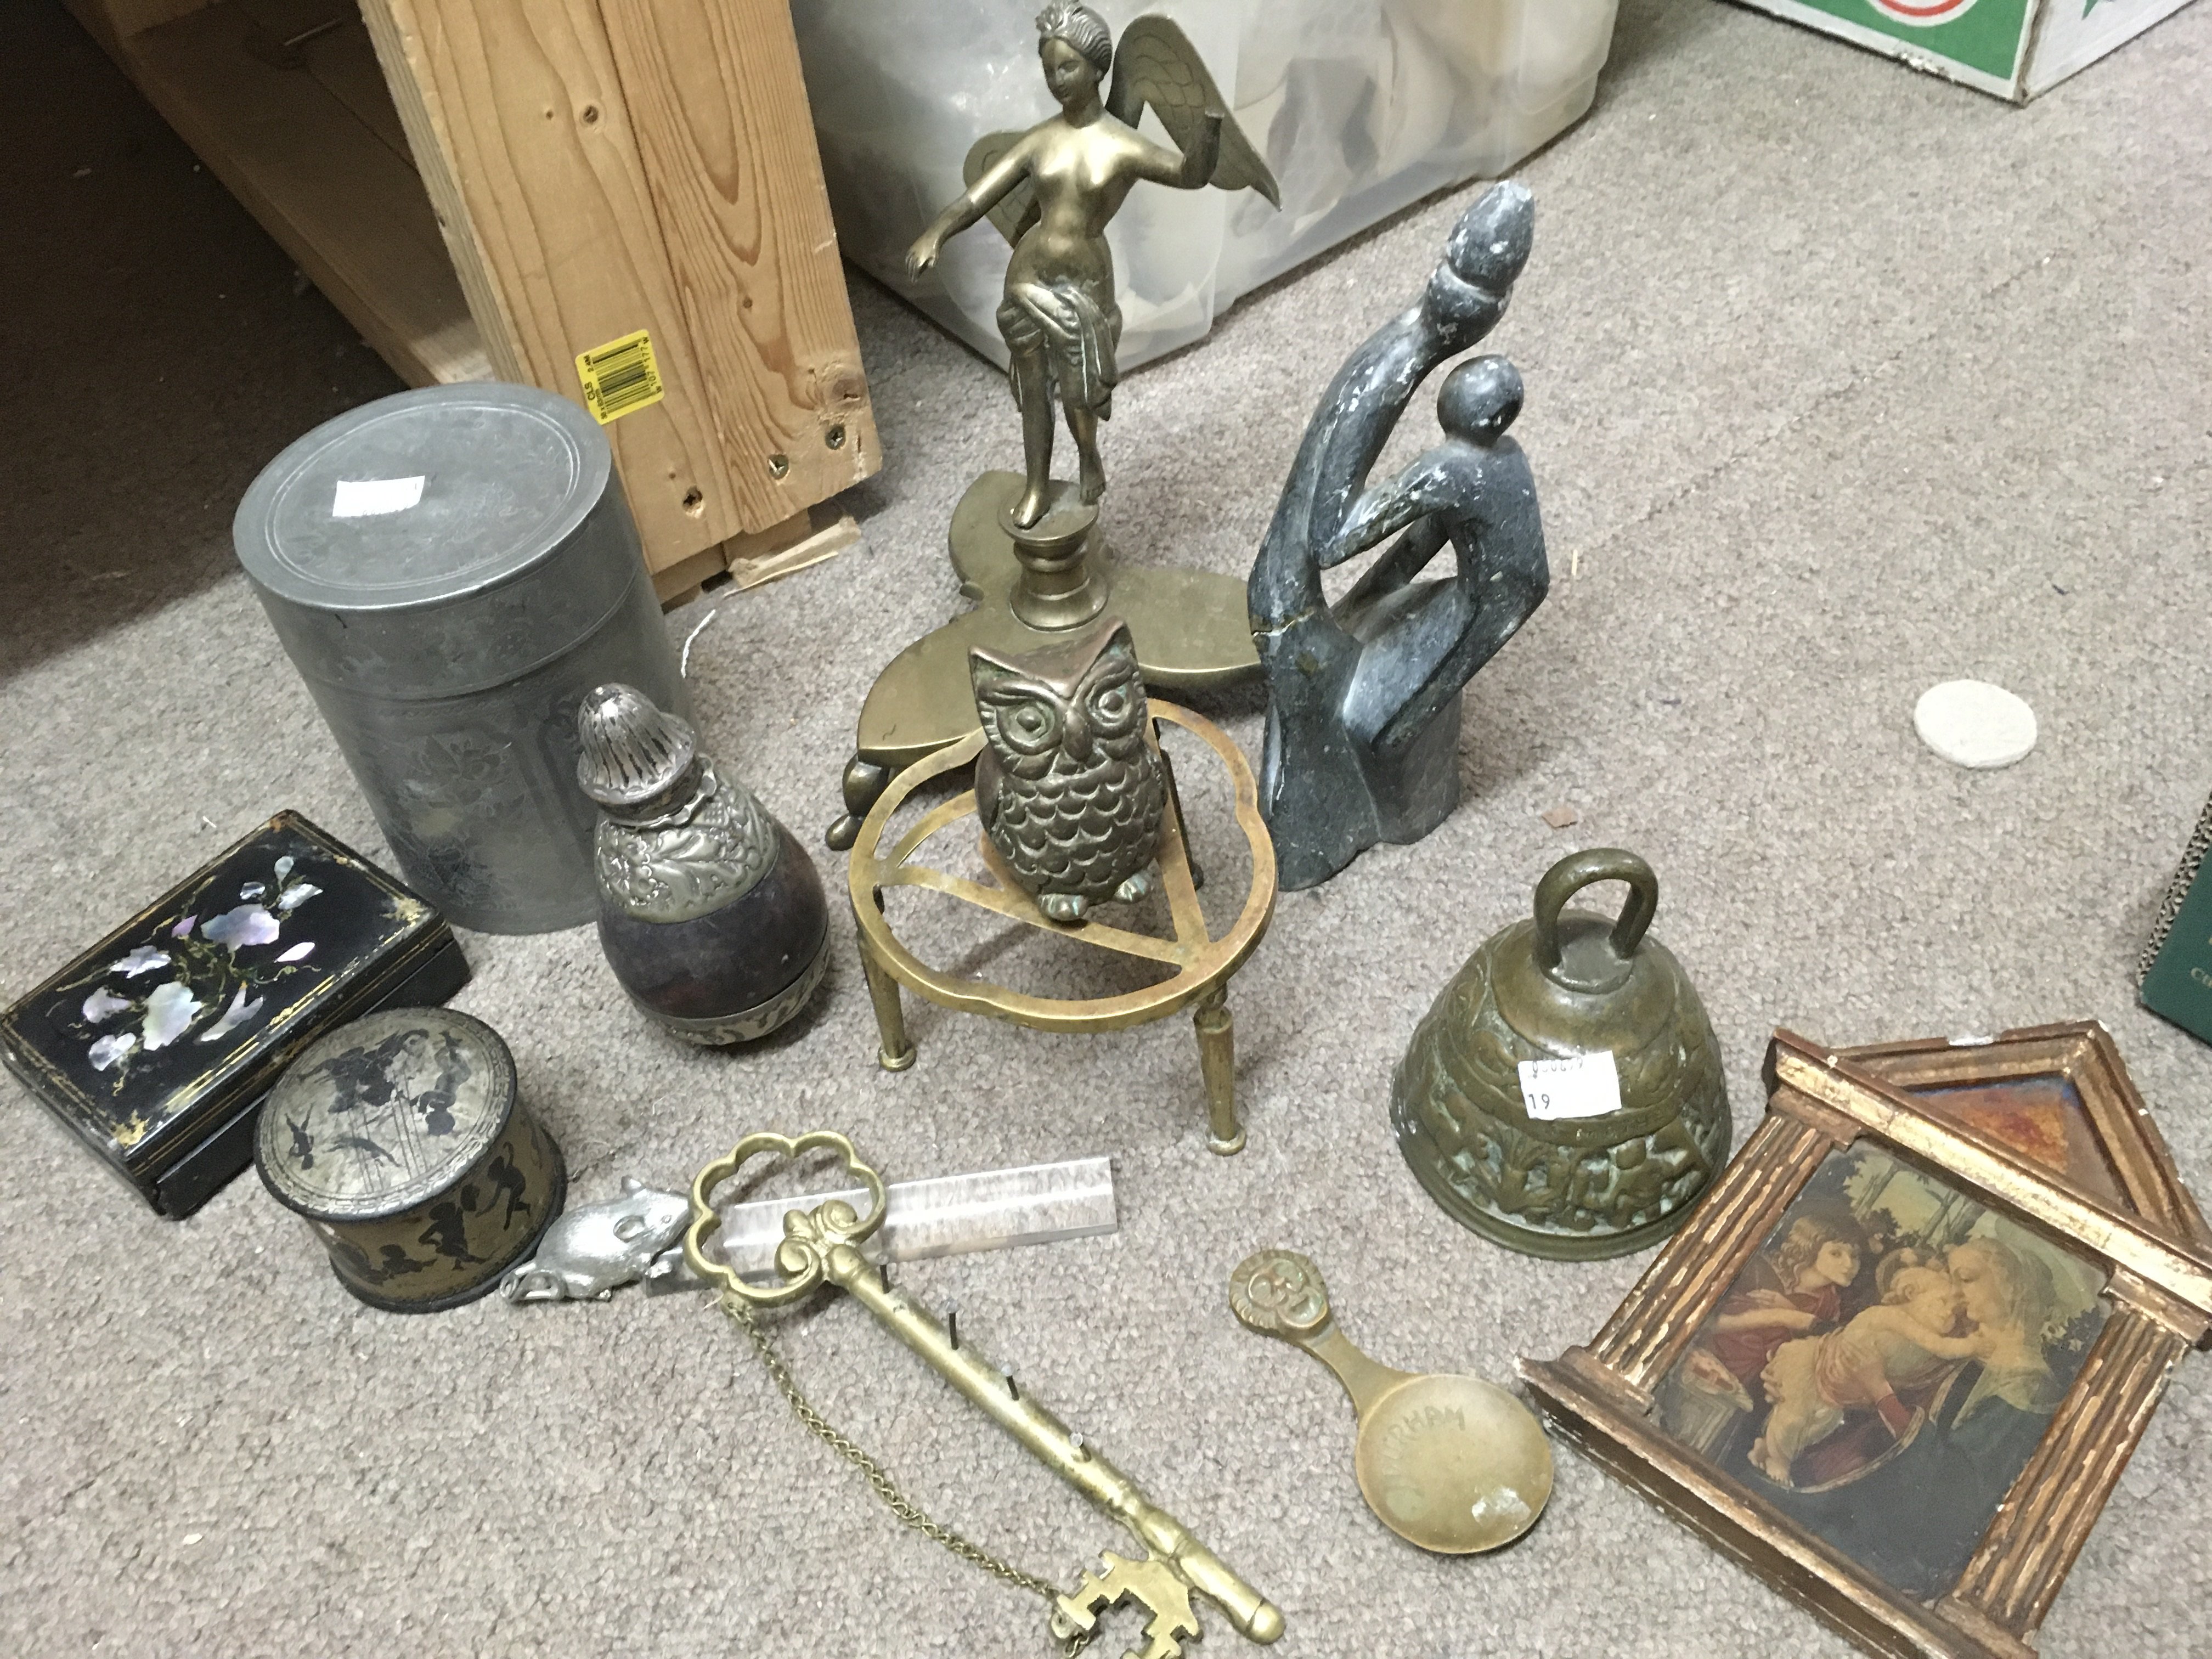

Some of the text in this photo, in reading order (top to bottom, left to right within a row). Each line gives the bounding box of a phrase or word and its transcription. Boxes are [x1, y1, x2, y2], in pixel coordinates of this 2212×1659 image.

[640, 347, 651, 363] 177
[647, 371, 657, 386] 107
[584, 381, 595, 400] CLS
[1528, 1093, 1550, 1110] 19
[1381, 1405, 1466, 1477] DURHAM
